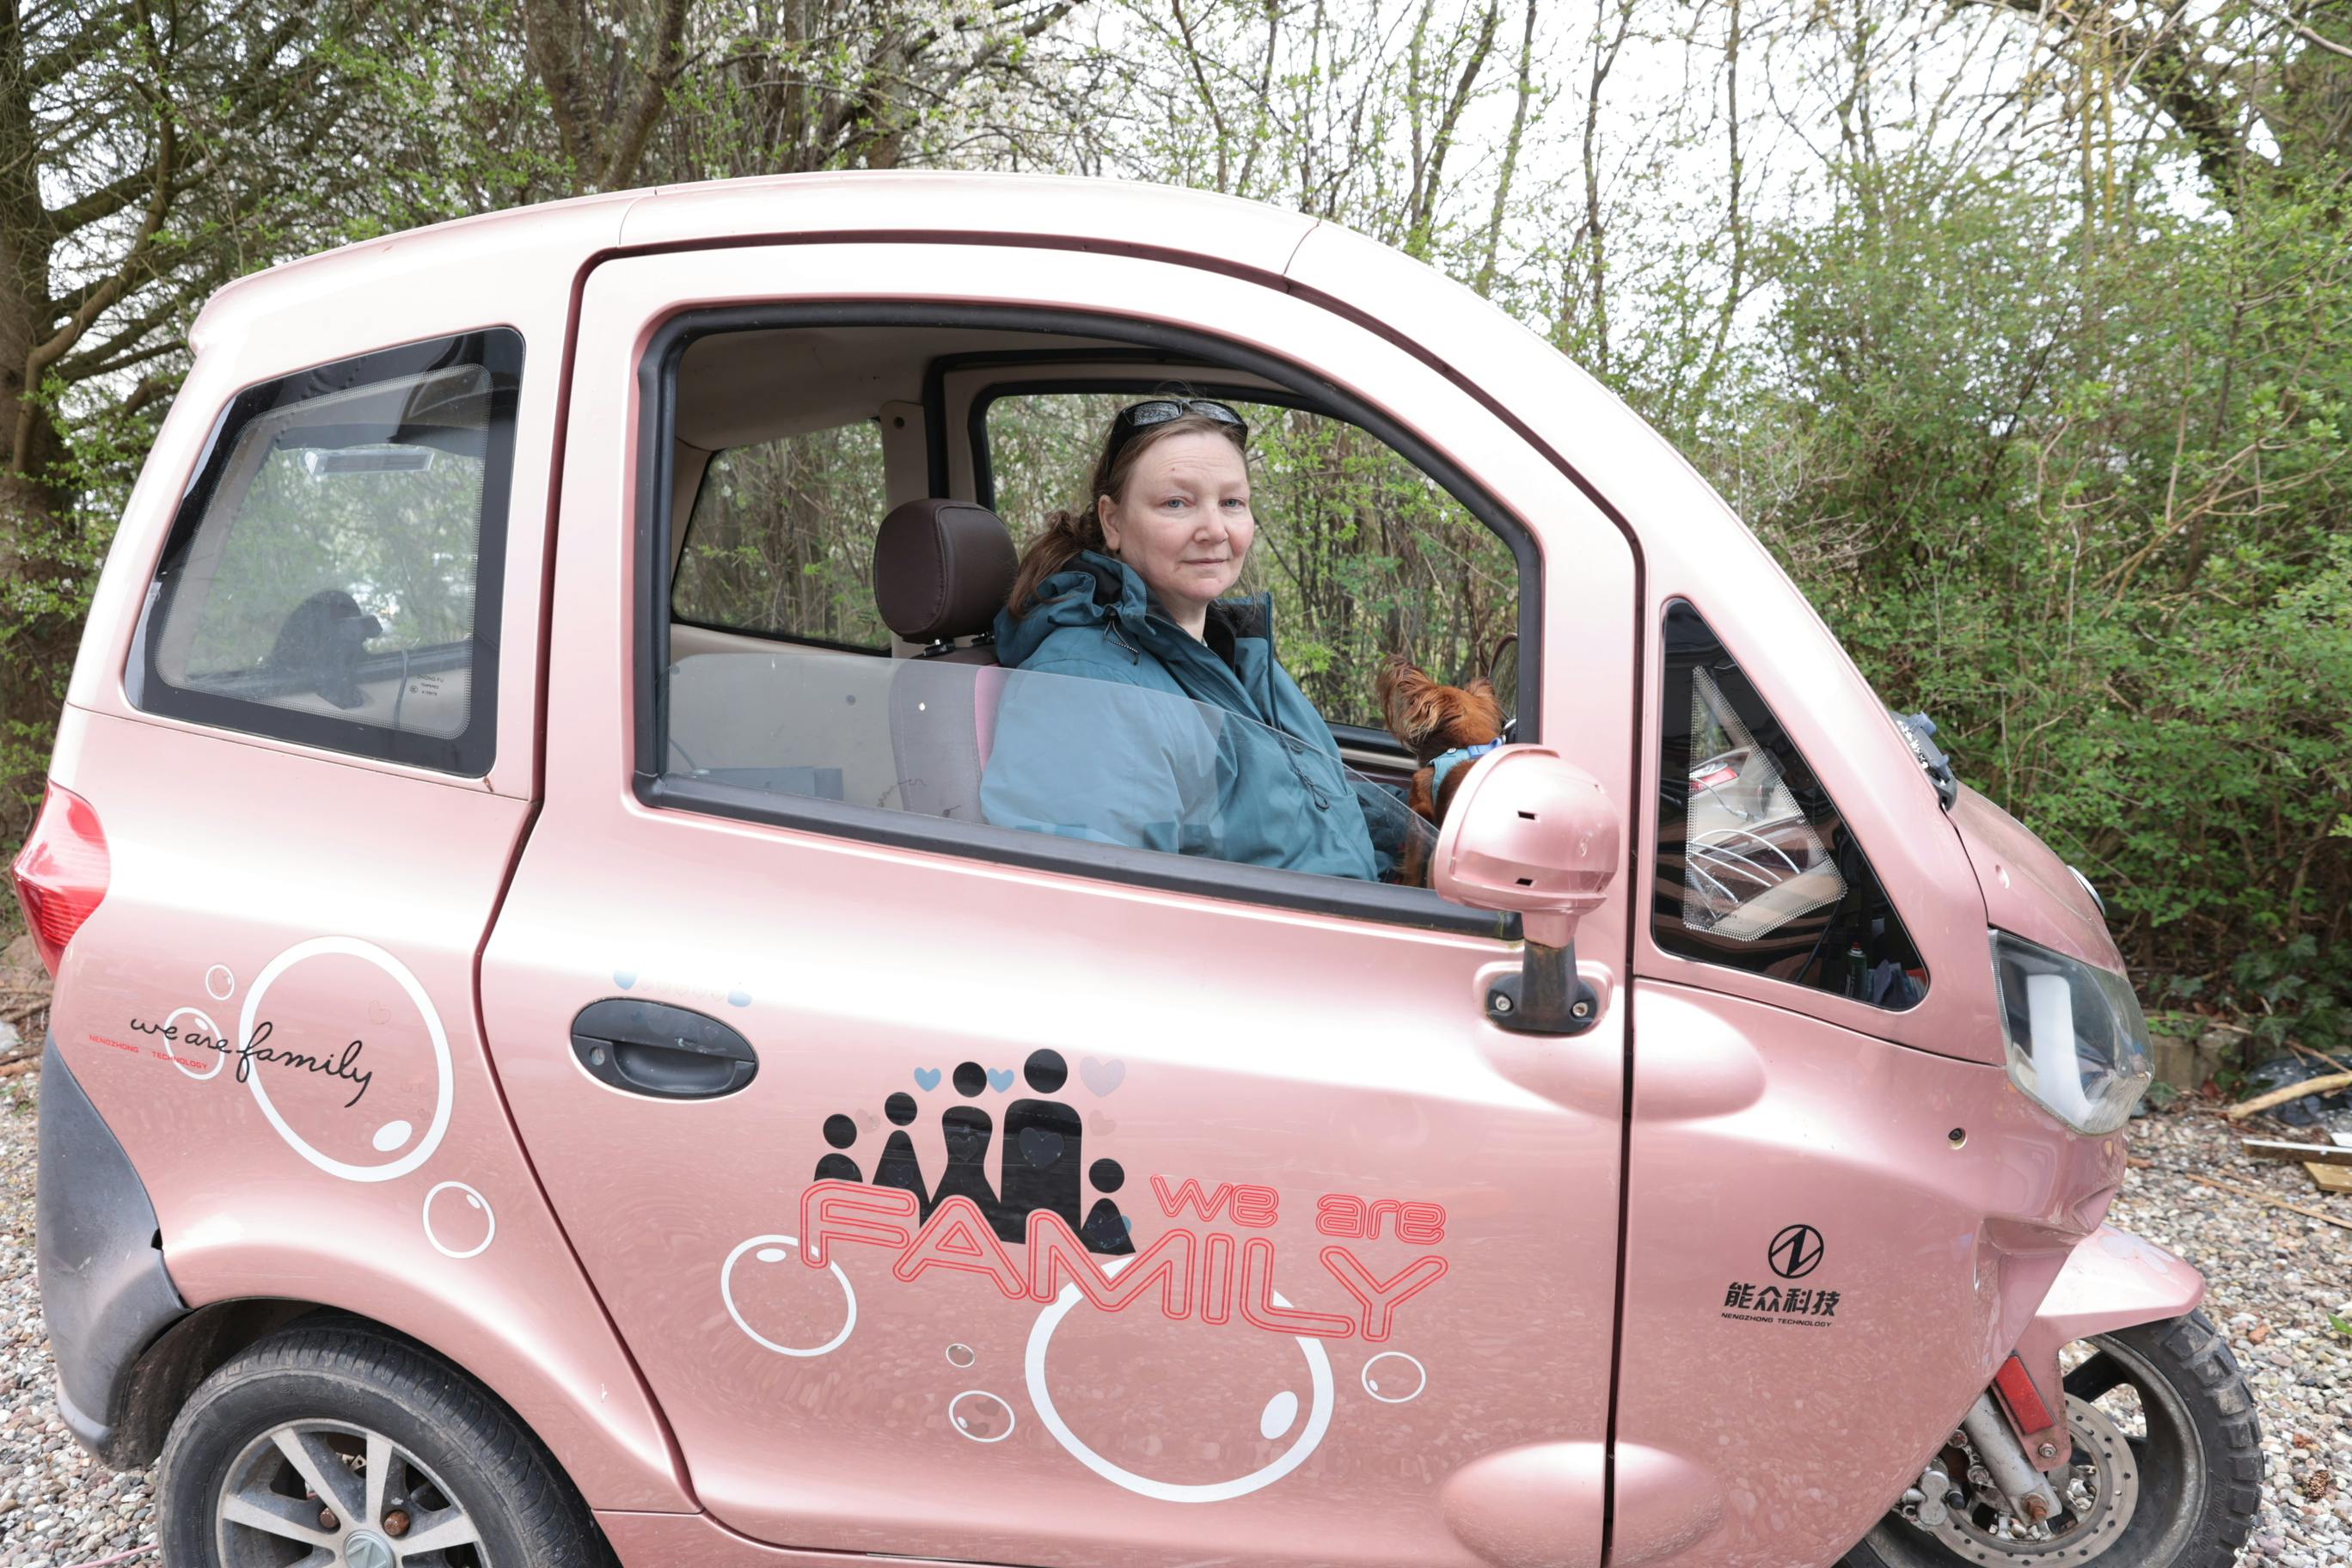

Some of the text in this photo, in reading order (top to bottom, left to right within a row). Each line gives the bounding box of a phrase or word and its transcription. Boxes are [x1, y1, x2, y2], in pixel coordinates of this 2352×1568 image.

[130, 1019, 372, 1108] we are family
[1315, 1192, 1448, 1246] are
[799, 1179, 1449, 1344] FAMILY
[1721, 1312, 1833, 1328] NENGZHONG TECHNOLOGY
[1724, 1281, 1841, 1317] 能众科技
